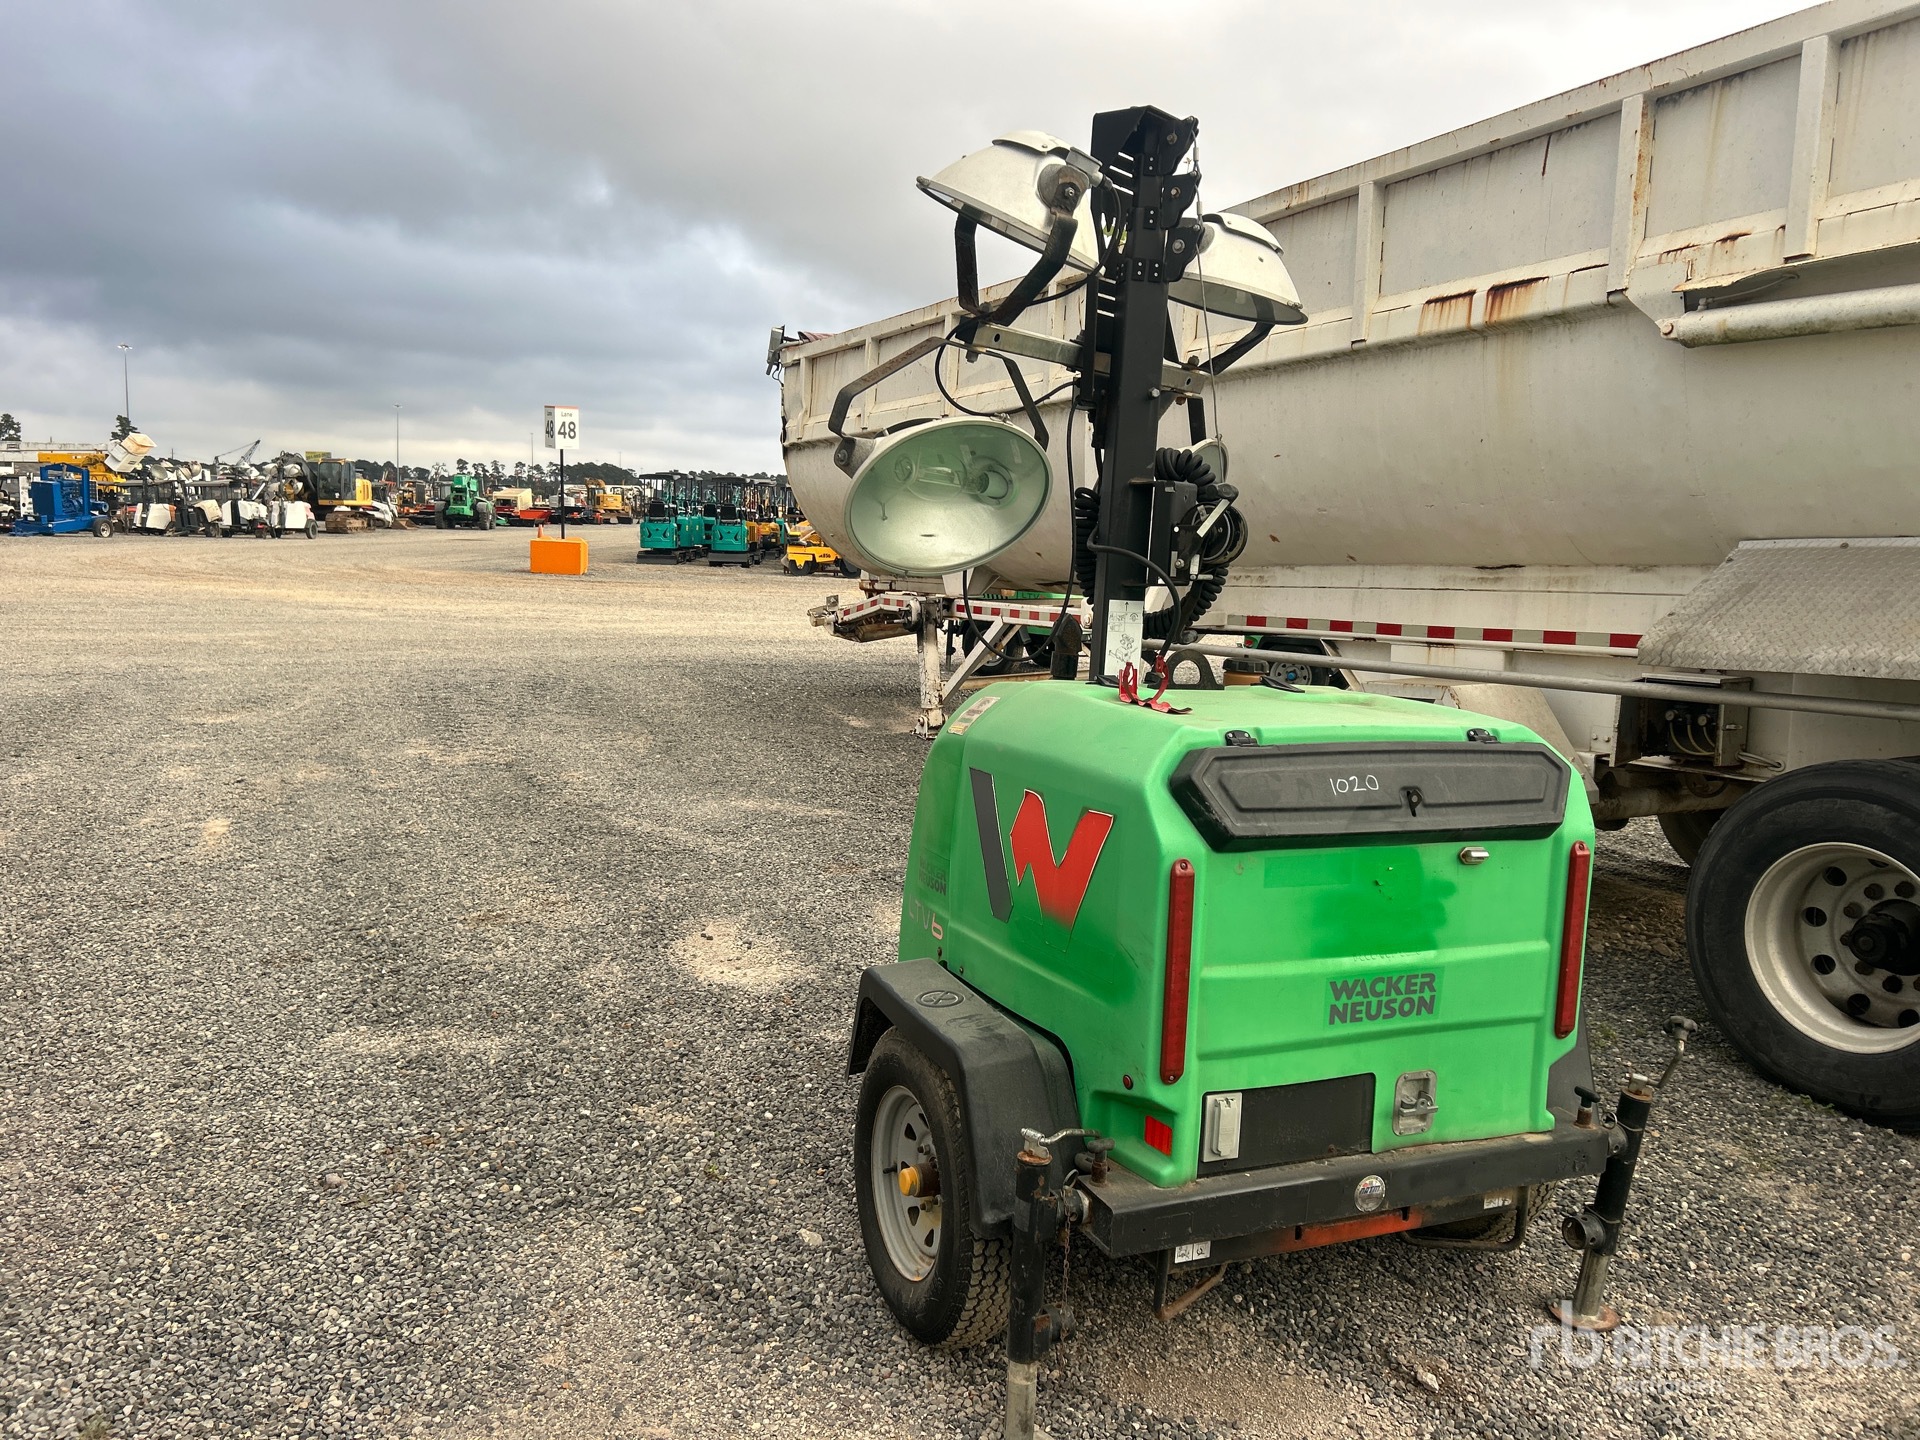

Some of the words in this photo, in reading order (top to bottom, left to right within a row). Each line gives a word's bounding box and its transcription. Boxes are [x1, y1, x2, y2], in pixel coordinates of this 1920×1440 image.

[545, 419, 554, 439] 48
[557, 420, 577, 440] 48
[1329, 774, 1379, 796] 1020
[1329, 973, 1437, 1002] WACKER
[1328, 994, 1436, 1026] NEUSON
